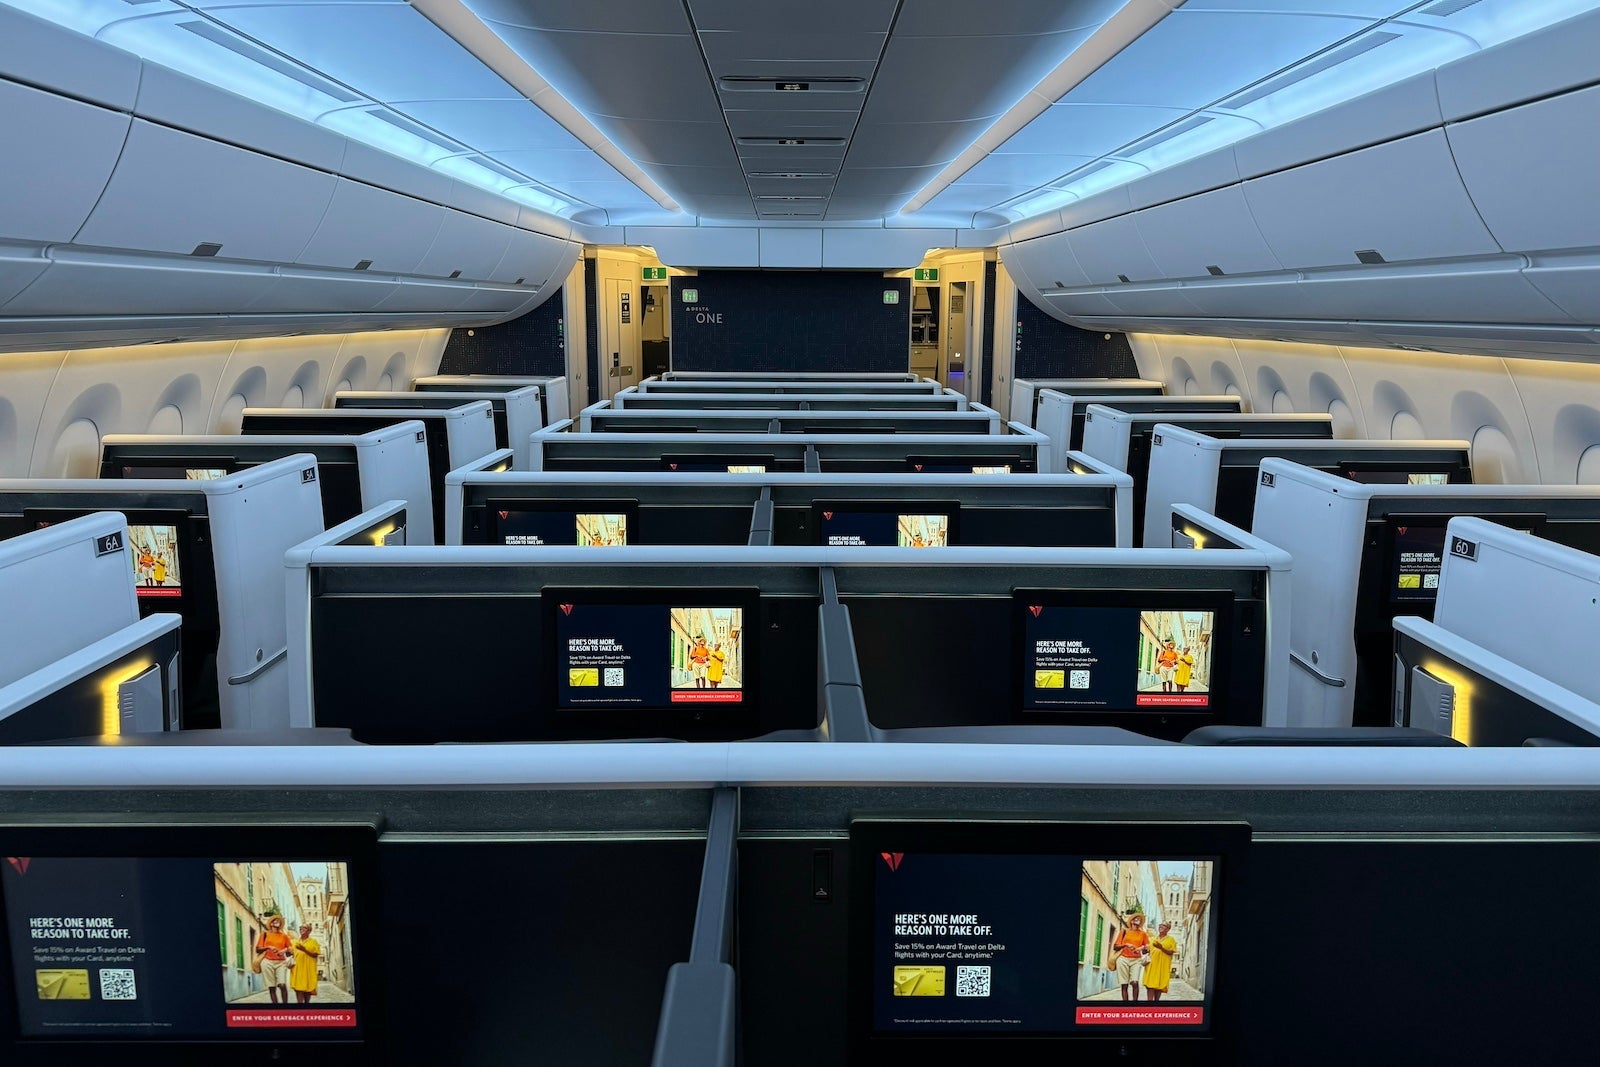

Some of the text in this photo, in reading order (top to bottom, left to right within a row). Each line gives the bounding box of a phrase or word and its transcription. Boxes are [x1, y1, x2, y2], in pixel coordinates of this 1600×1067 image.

[696, 312, 723, 324] ONE
[106, 536, 119, 550] 6A
[1456, 541, 1468, 554] 6D
[30, 918, 114, 929] HERE'S ONE MORE
[895, 914, 978, 925] HERE'S ONE MORE
[31, 929, 131, 940] REASON TO TAKE OFF.
[895, 925, 993, 936] REASON TO TAKE OFF.
[987, 943, 1006, 951] Delta
[894, 951, 915, 960] flights
[915, 951, 930, 959] with
[930, 953, 945, 961] your
[946, 951, 964, 960] Card,
